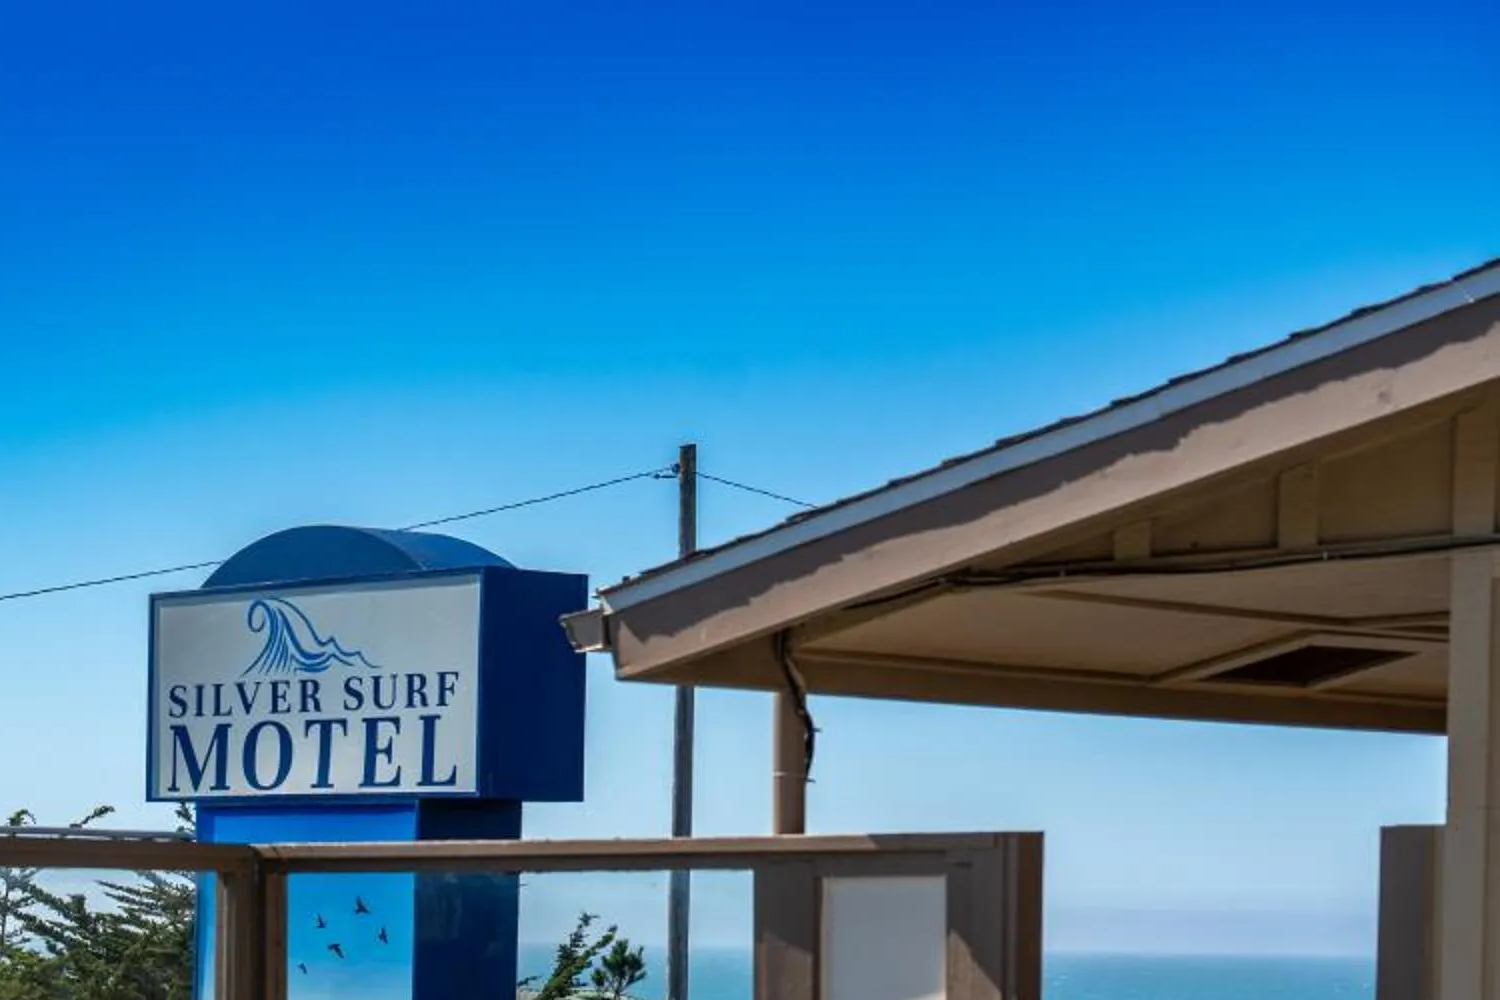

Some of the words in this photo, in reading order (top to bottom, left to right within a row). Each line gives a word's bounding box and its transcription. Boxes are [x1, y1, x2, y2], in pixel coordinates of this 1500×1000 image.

[168, 679, 322, 719] SILVER
[343, 671, 459, 711] SURF
[167, 714, 458, 793] MOTEL
